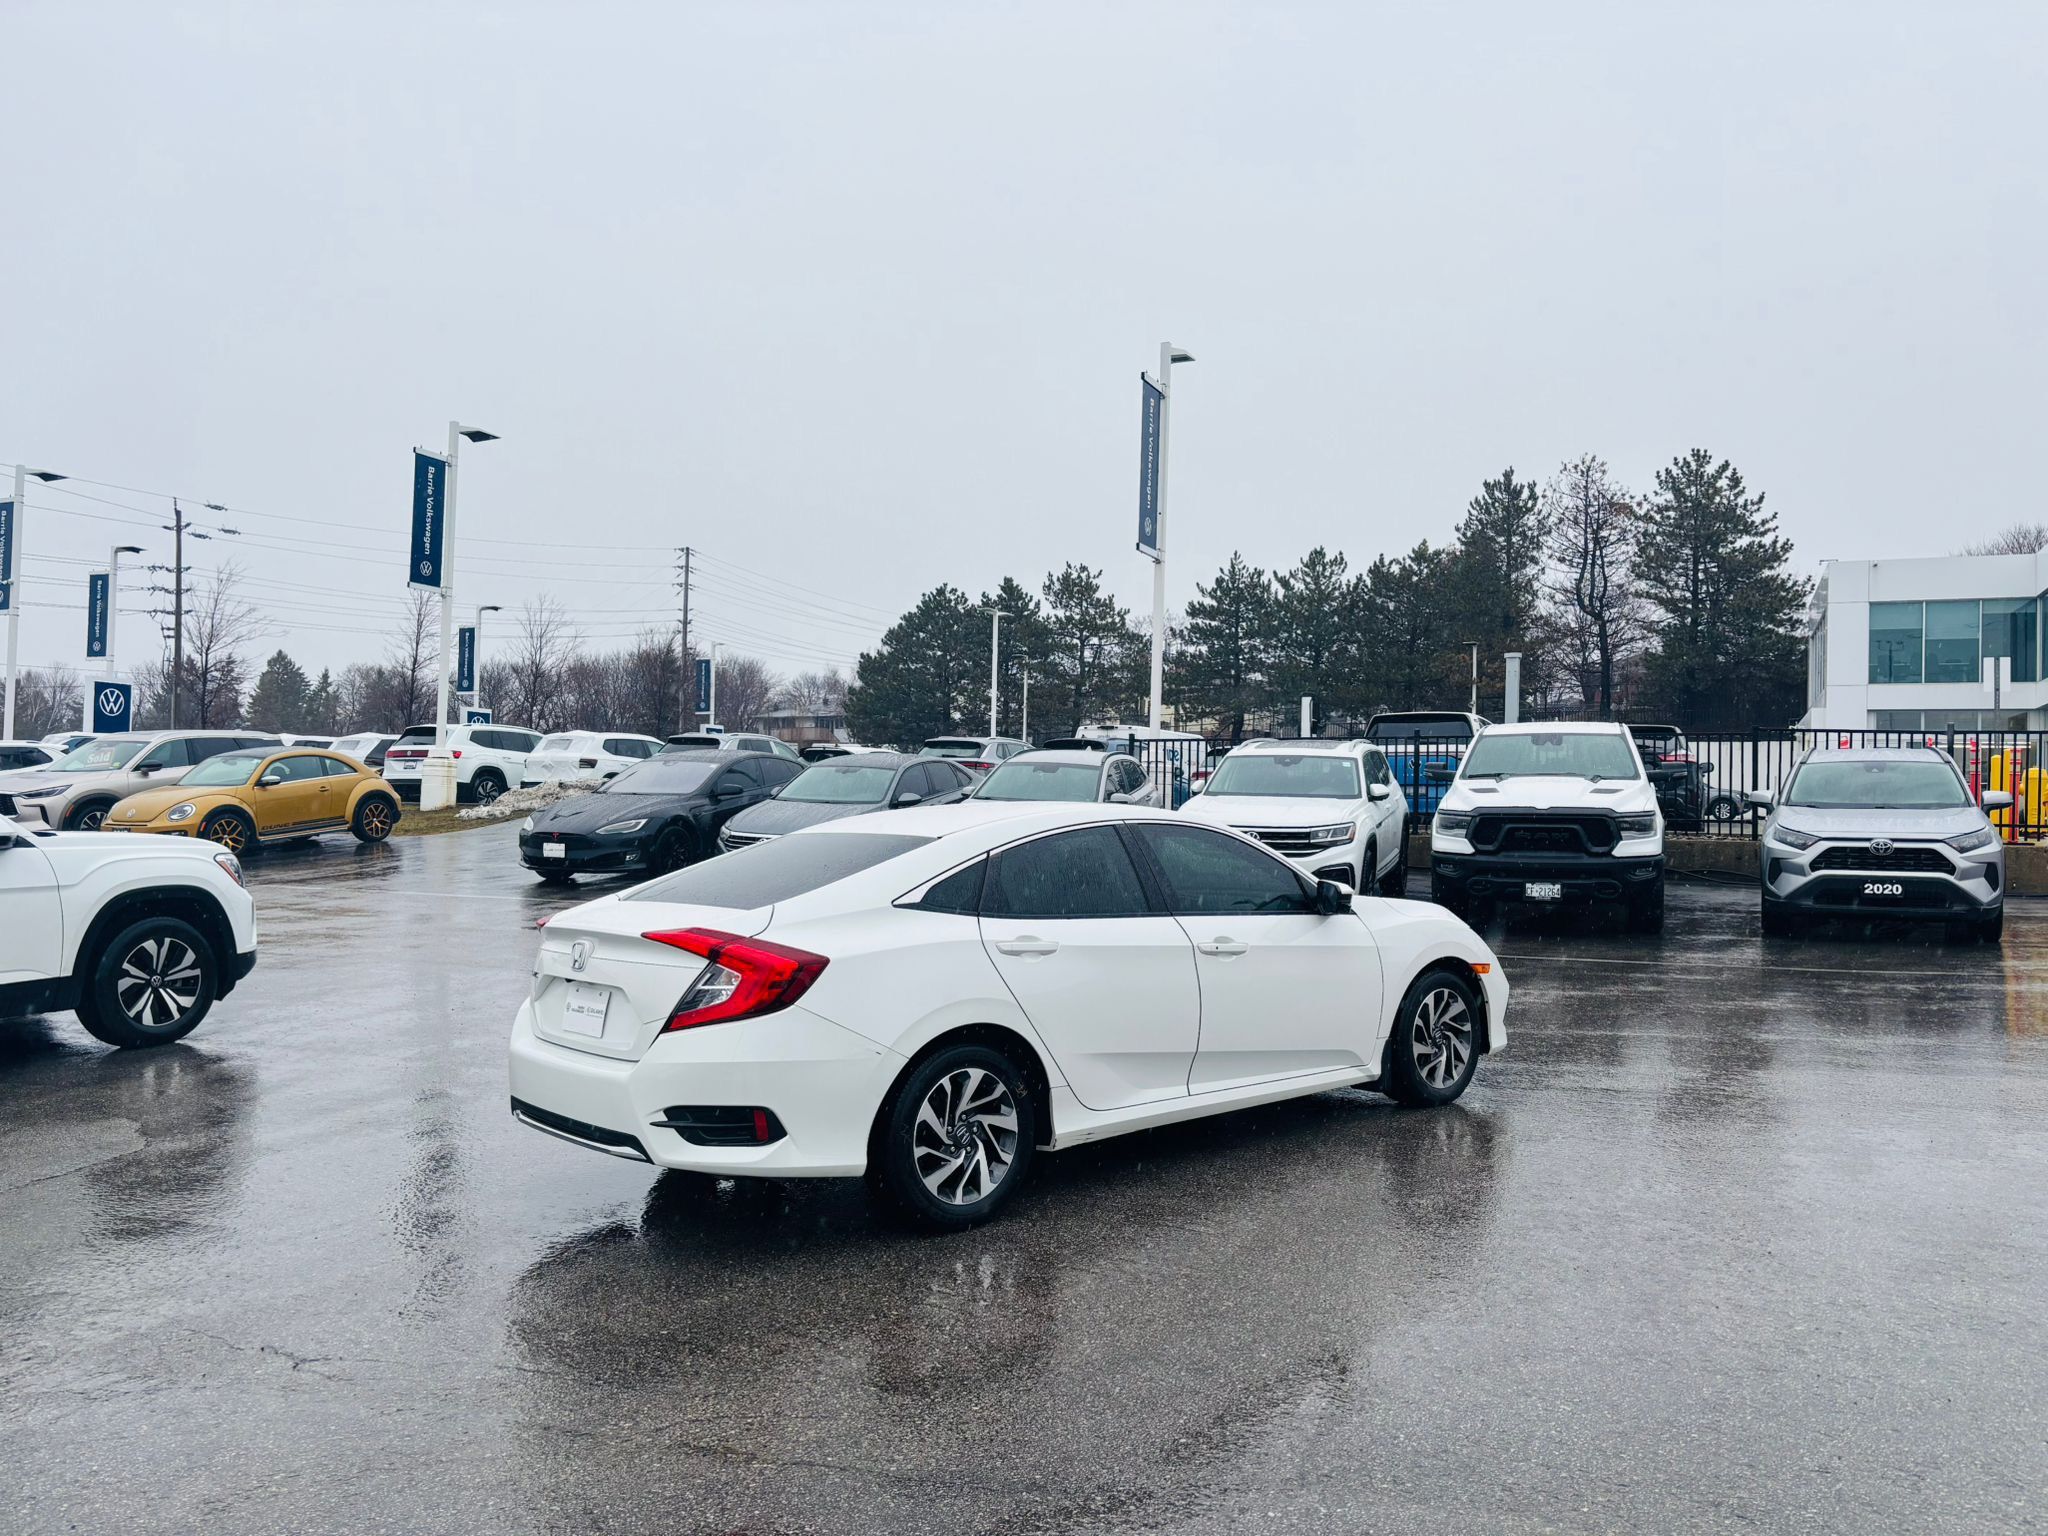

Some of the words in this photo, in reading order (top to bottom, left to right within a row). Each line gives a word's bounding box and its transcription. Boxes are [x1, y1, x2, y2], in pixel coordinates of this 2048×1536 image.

[426, 466, 435, 495] Barrie
[423, 496, 435, 555] Volkswagen
[1863, 883, 1903, 895] 2020
